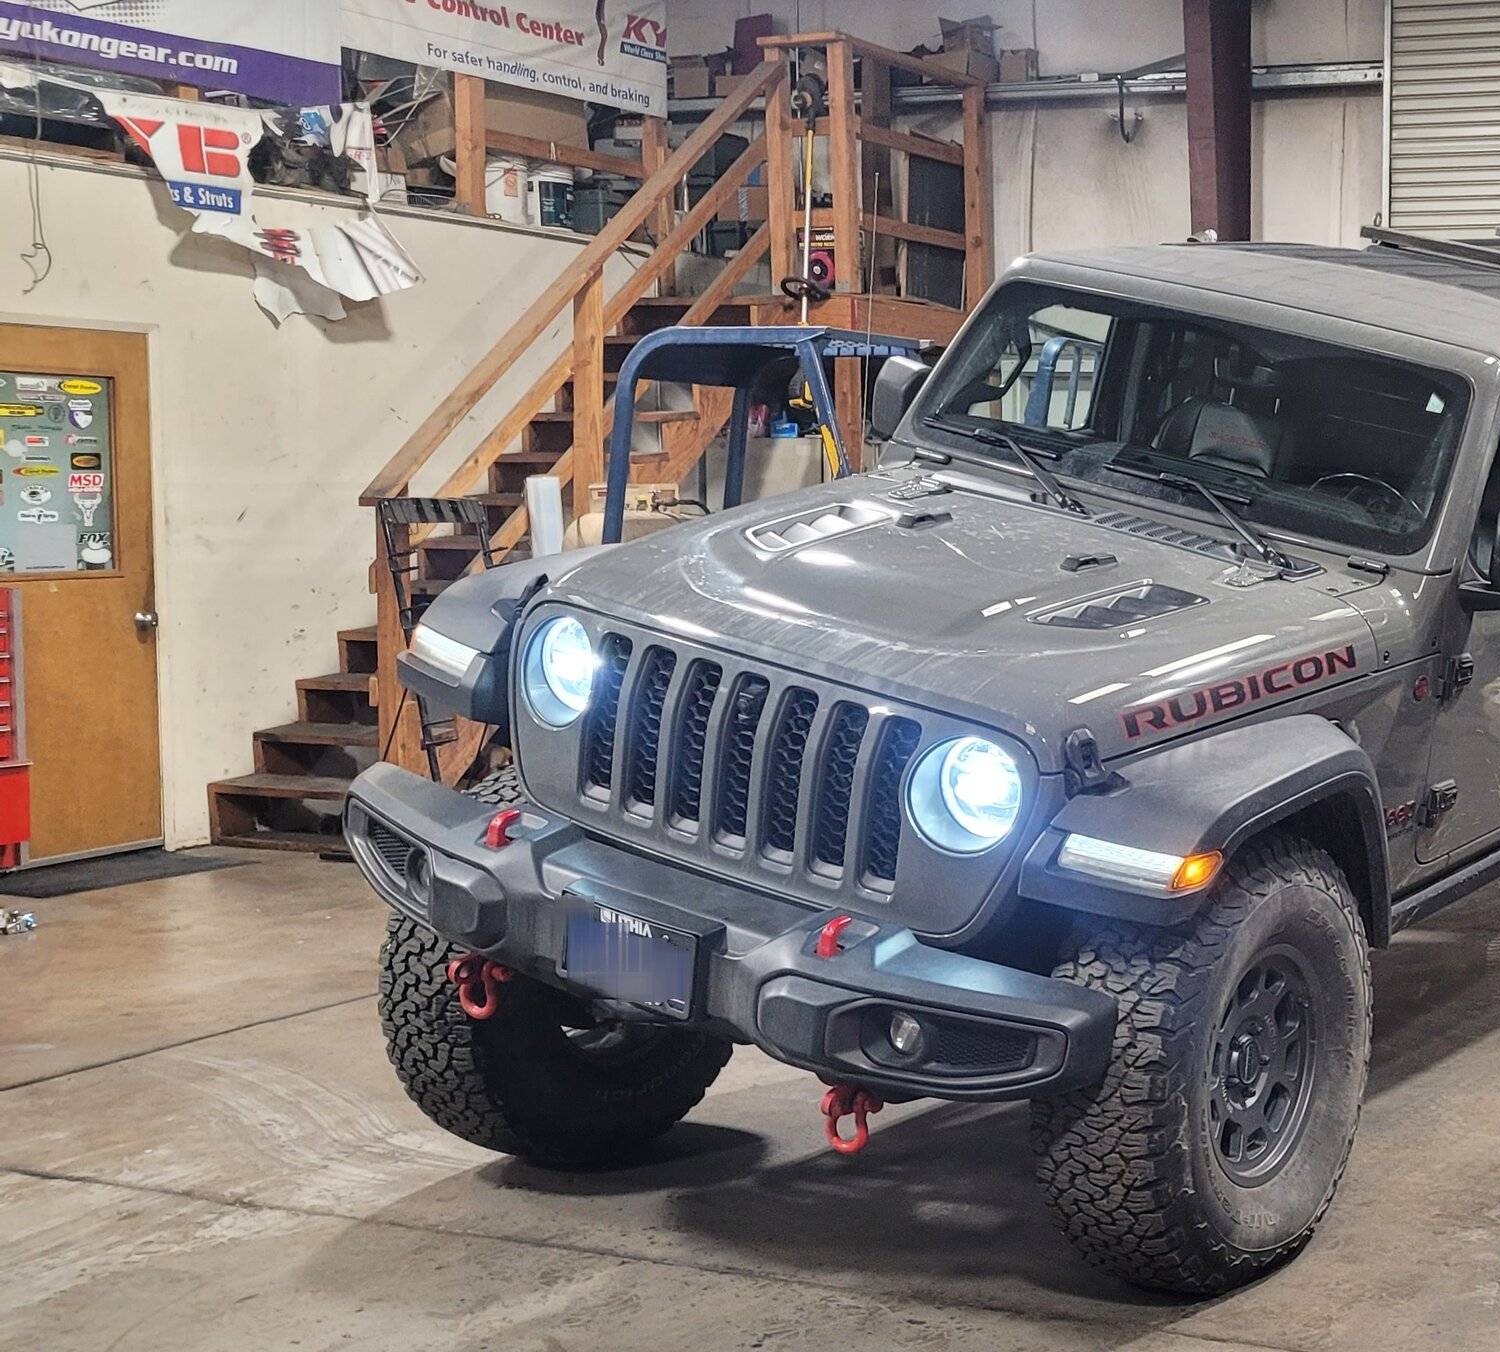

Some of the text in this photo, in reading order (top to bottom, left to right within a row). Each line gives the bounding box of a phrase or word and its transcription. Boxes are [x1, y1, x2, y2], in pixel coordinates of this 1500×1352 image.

[0, 17, 238, 75] yukongear.com
[516, 12, 585, 46] Center
[427, 42, 650, 107] For safer handling, control, and braking
[183, 186, 194, 204] &
[198, 187, 234, 209] Struts
[70, 475, 102, 487] MSD
[1120, 643, 1359, 740] RUBICON
